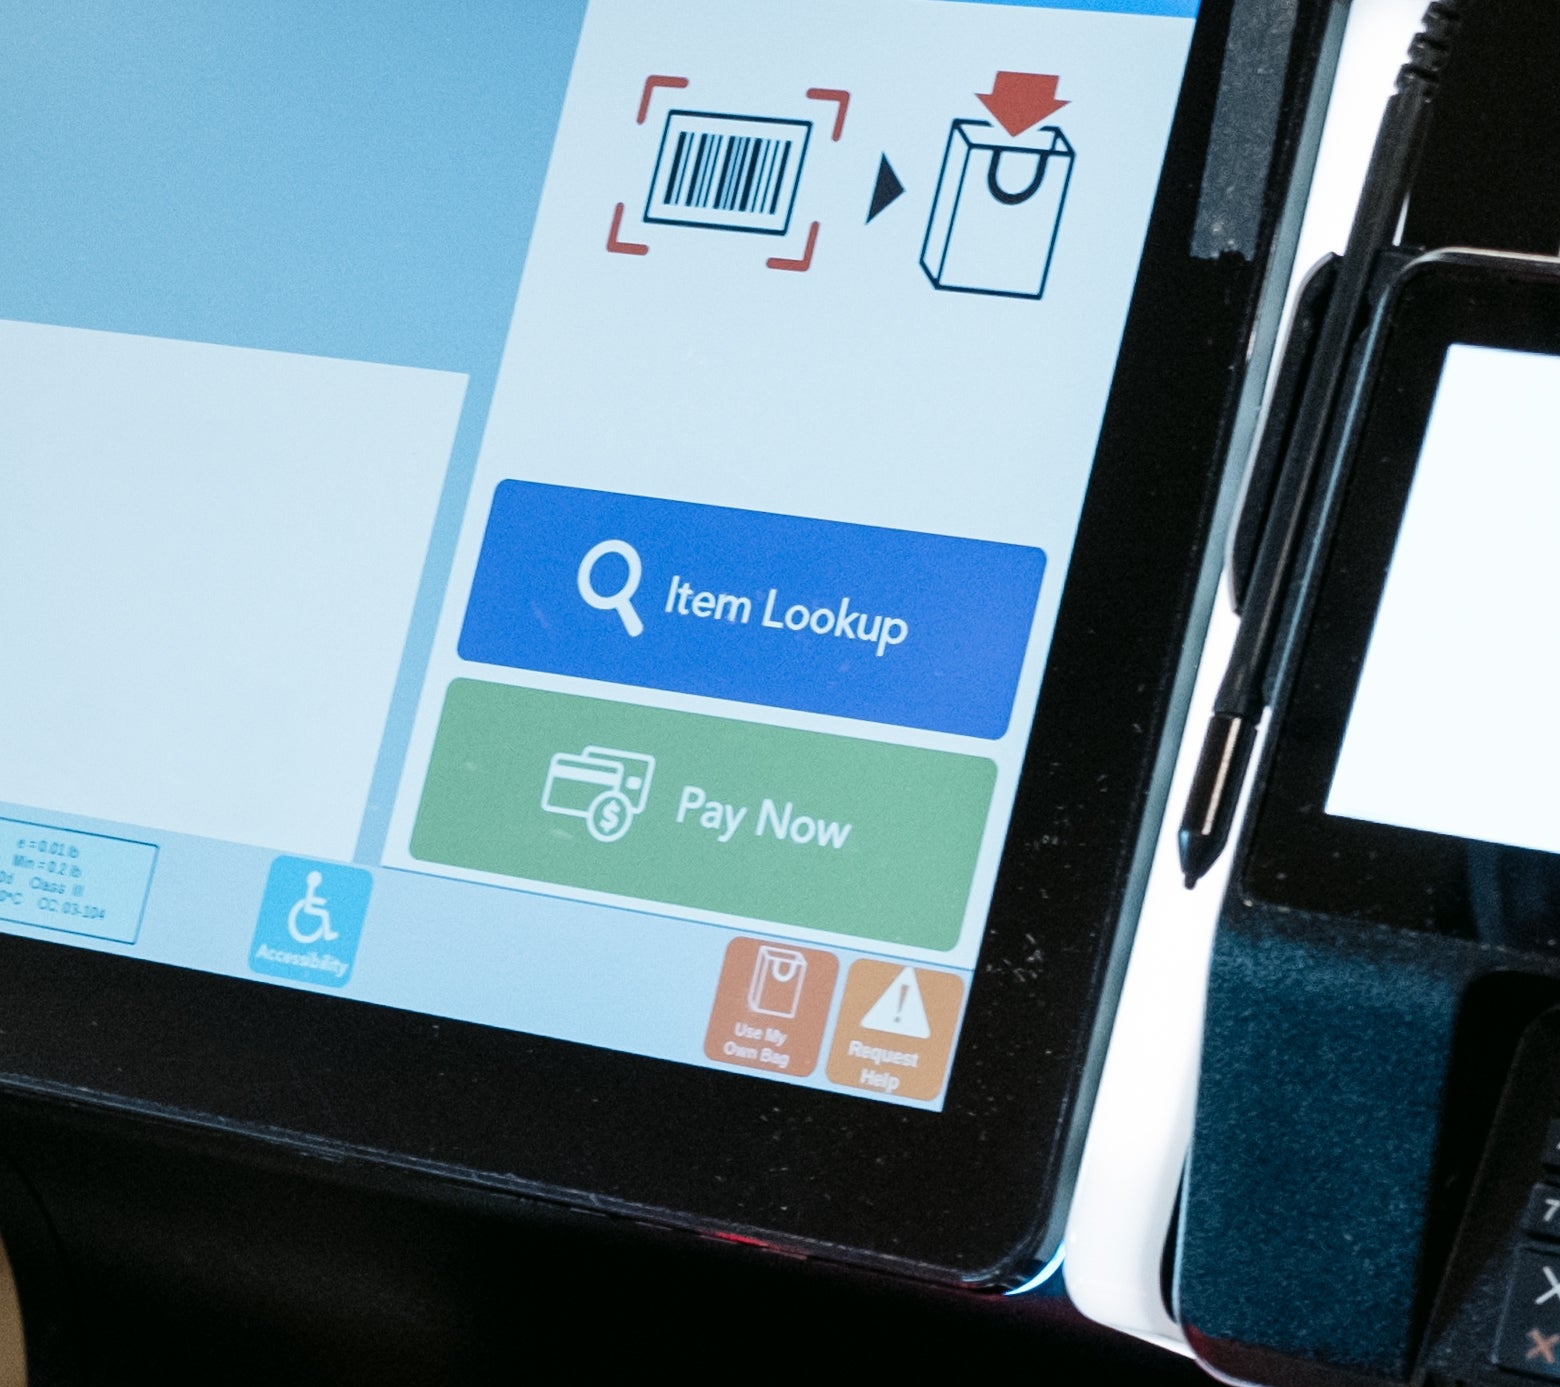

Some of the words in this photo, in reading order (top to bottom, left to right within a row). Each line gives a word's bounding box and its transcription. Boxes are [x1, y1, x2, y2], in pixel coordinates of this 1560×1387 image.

[665, 575, 751, 624] Item
[761, 588, 909, 657] Lookup
[676, 785, 748, 843] Pay
[755, 798, 852, 849] Now
[29, 876, 67, 895] Class
[733, 1022, 762, 1042] Use
[765, 1027, 788, 1047] My
[723, 1040, 757, 1060] Own
[760, 1046, 791, 1069] Bag
[848, 1040, 919, 1068] Request
[860, 1068, 901, 1094] Help
